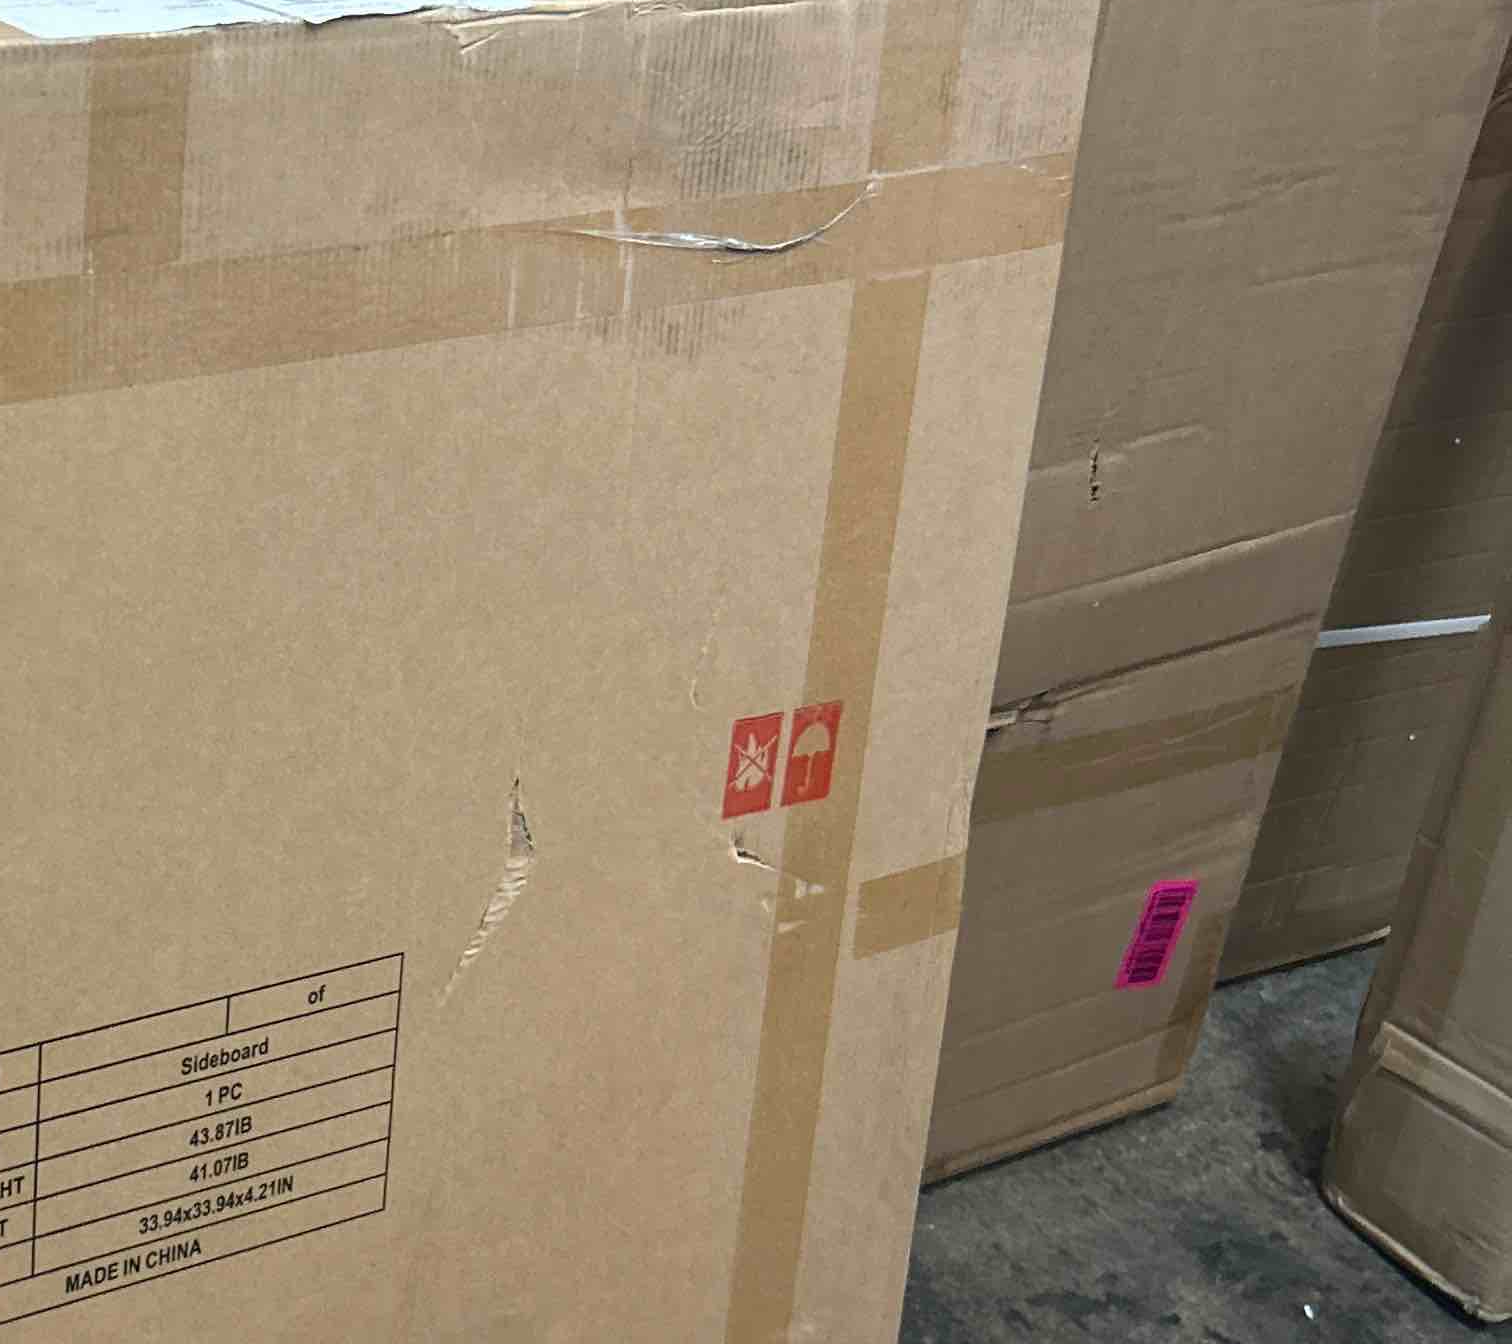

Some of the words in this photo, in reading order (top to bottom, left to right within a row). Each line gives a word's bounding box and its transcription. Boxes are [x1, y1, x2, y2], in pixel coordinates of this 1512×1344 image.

[307, 984, 327, 1006] of
[180, 1036, 270, 1076] Sideboard
[204, 1089, 213, 1107] 1
[217, 1081, 243, 1105] PC
[138, 1175, 294, 1235] 33.94x33.94x4.21IN
[64, 1261, 120, 1295] MADE
[122, 1255, 142, 1277] IN
[145, 1238, 202, 1270] CHINA
